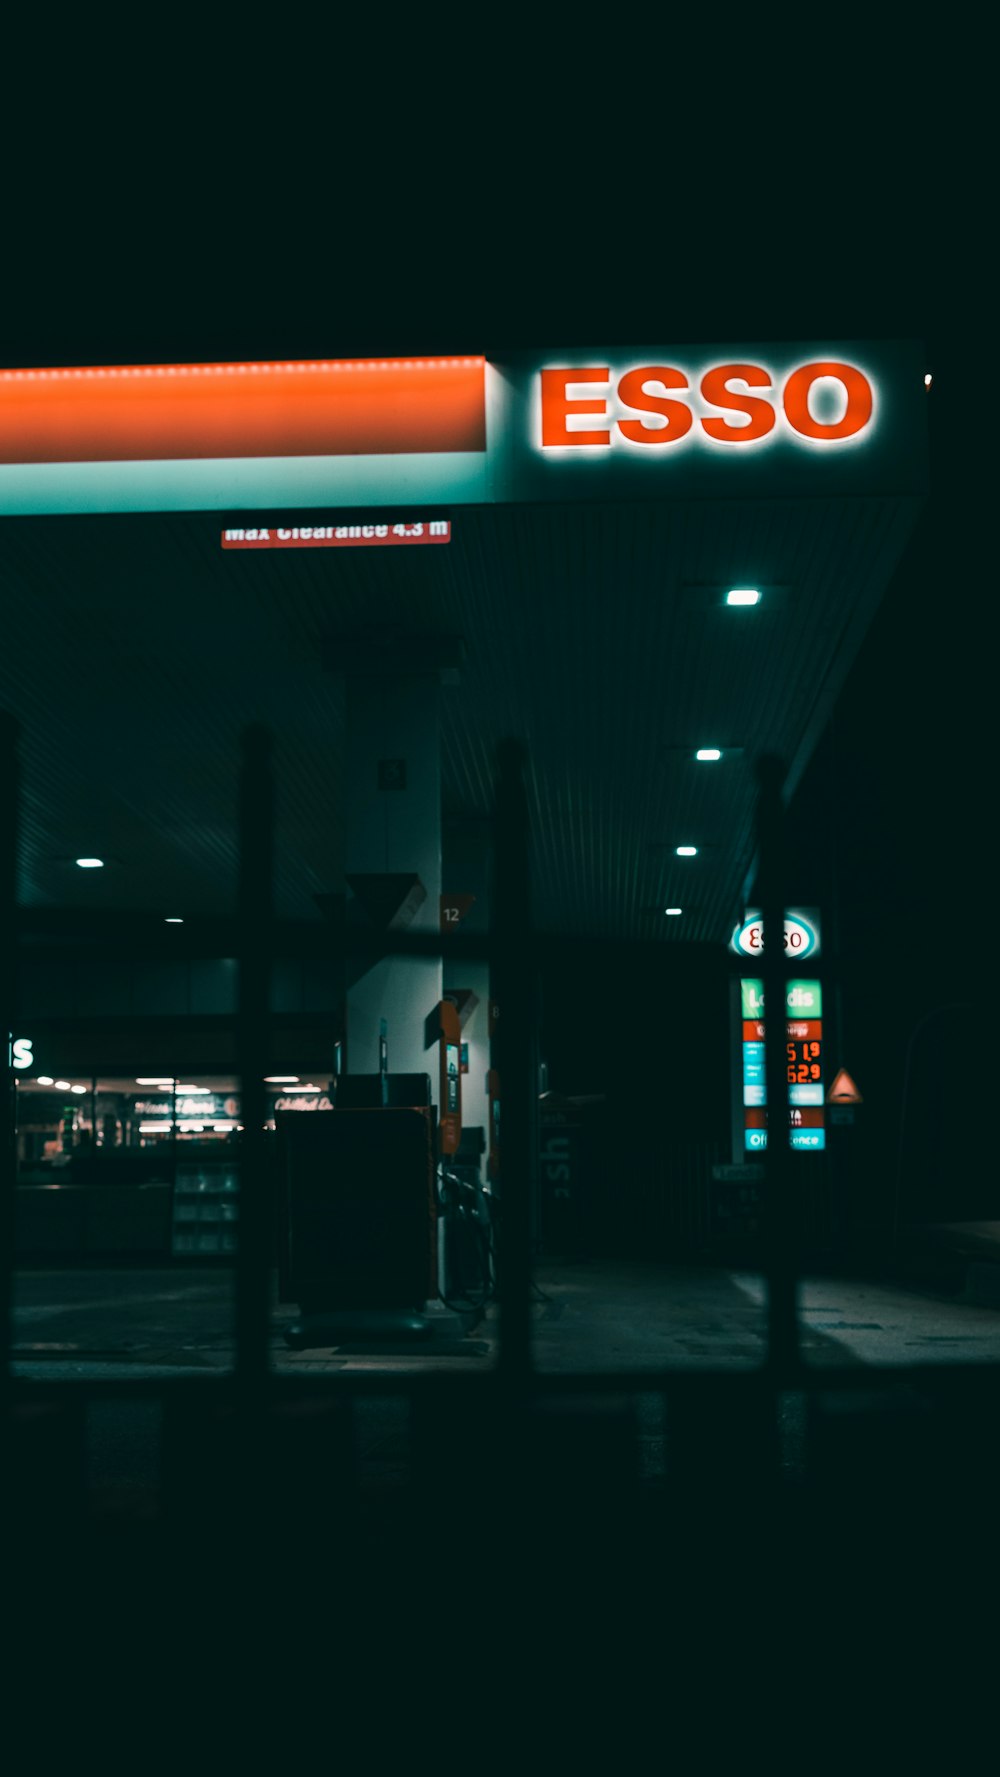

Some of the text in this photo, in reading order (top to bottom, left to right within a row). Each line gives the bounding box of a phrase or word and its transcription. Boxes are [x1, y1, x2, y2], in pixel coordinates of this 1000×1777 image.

[541, 362, 873, 447] ESSO
[225, 521, 448, 541] Max Clearance 4.3 m
[443, 907, 460, 922] 12
[749, 928, 802, 948] Eo
[749, 987, 814, 1008] Ldis
